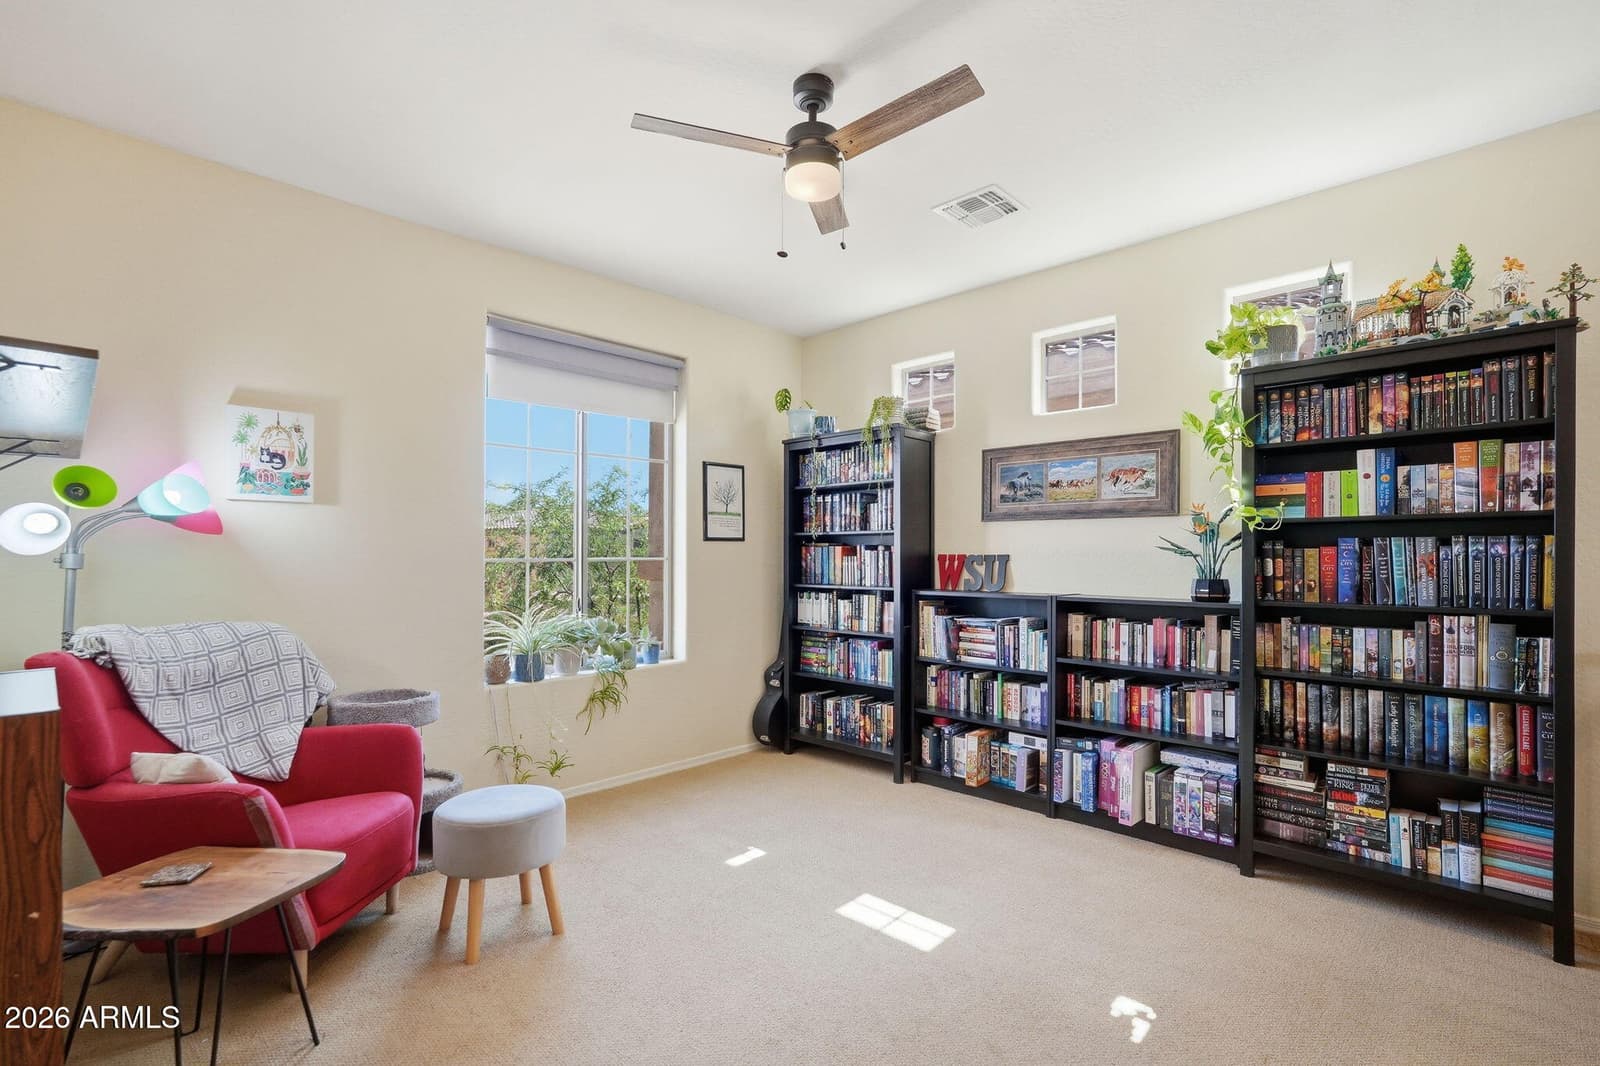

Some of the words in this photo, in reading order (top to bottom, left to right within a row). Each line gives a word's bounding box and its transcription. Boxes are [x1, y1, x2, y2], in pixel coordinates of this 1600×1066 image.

[937, 554, 1010, 592] WSU
[1389, 701, 1399, 717] Lady
[1389, 717, 1400, 747] Midnight
[1336, 767, 1356, 775] KING
[1334, 782, 1354, 790] KING
